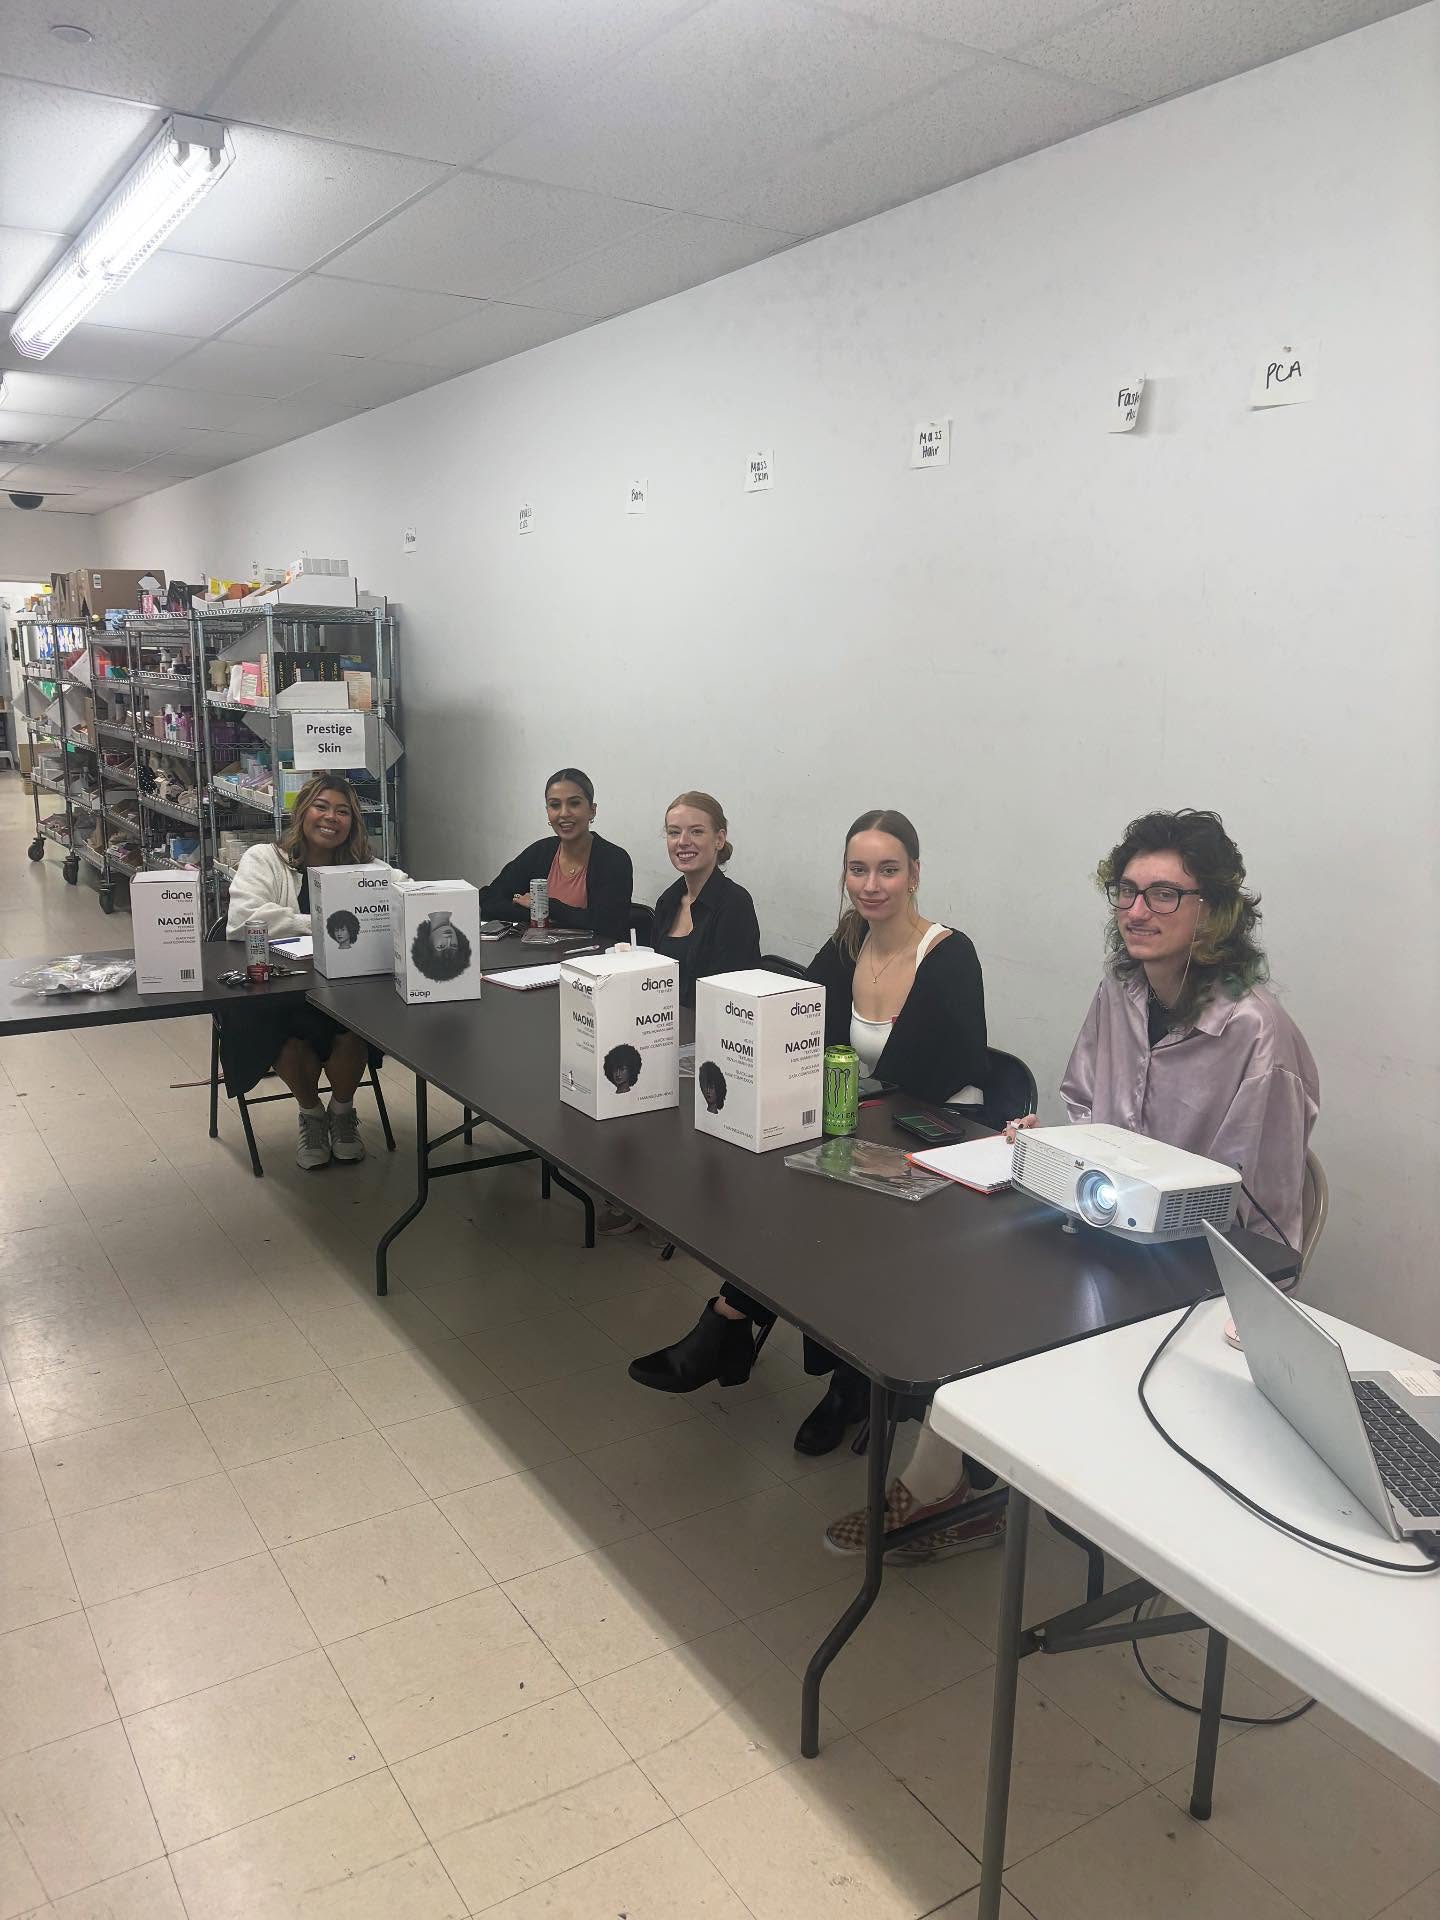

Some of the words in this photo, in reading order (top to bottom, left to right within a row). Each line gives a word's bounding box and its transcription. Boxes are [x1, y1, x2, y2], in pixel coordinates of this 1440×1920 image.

[1266, 360, 1302, 390] PCA
[919, 430, 942, 445] Mass
[922, 445, 940, 458] Hair
[750, 460, 768, 473] Mass
[306, 723, 353, 737] Prestige
[317, 742, 342, 753] Skin
[357, 878, 389, 888] diane
[161, 889, 193, 900] diane
[354, 904, 390, 915] NAOMI
[157, 916, 194, 926] NAOMI
[571, 977, 593, 996] diane
[641, 977, 674, 992] diane
[725, 1000, 754, 1021] diane
[790, 1001, 822, 1017] diane
[572, 1010, 595, 1029] NAOMI
[635, 1011, 674, 1027] NAOMI
[720, 1038, 754, 1058] NAOMI
[785, 1036, 821, 1054] NAOMI
